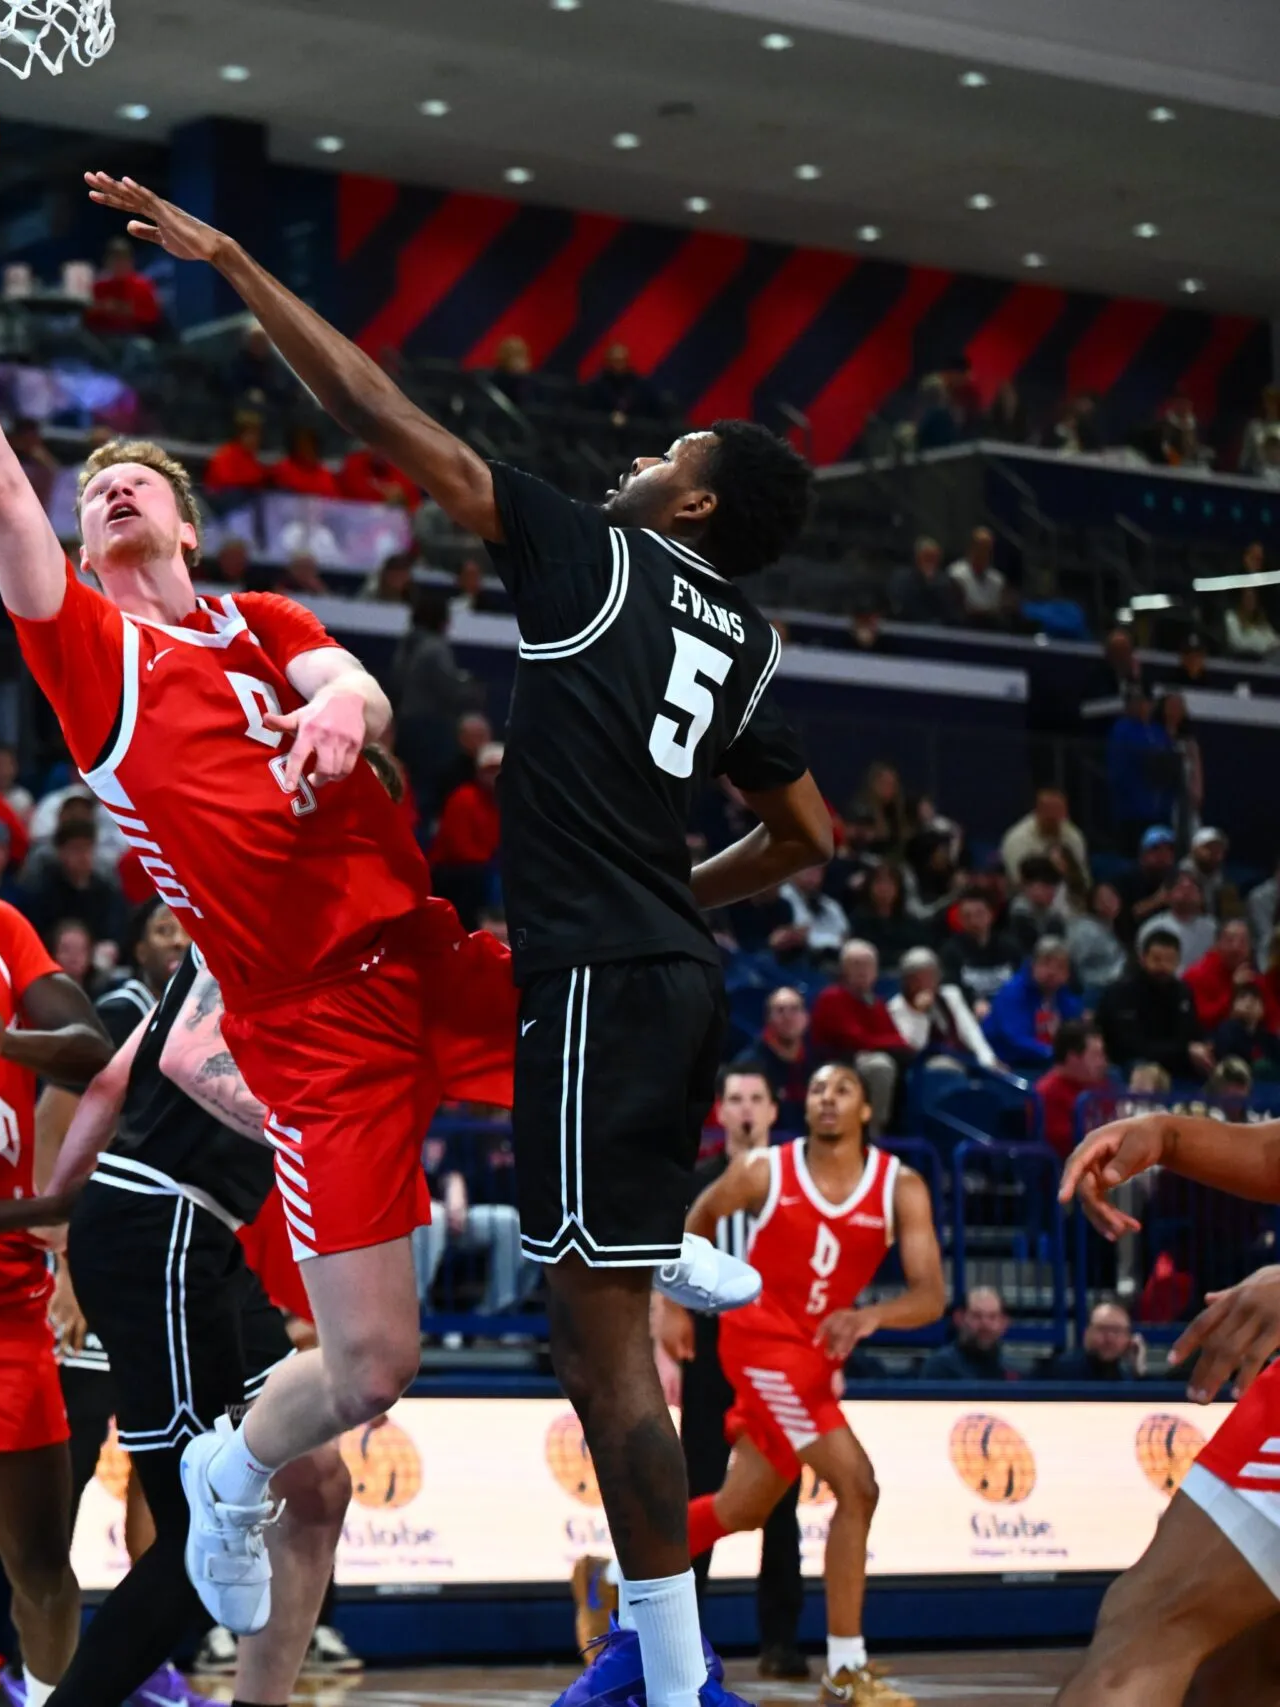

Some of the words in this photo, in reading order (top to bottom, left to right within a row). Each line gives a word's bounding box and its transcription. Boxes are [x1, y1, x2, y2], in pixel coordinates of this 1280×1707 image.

[670, 573, 746, 645] EVANS
[648, 626, 734, 779] 5
[808, 1220, 841, 1279] D
[805, 1279, 831, 1315] 5
